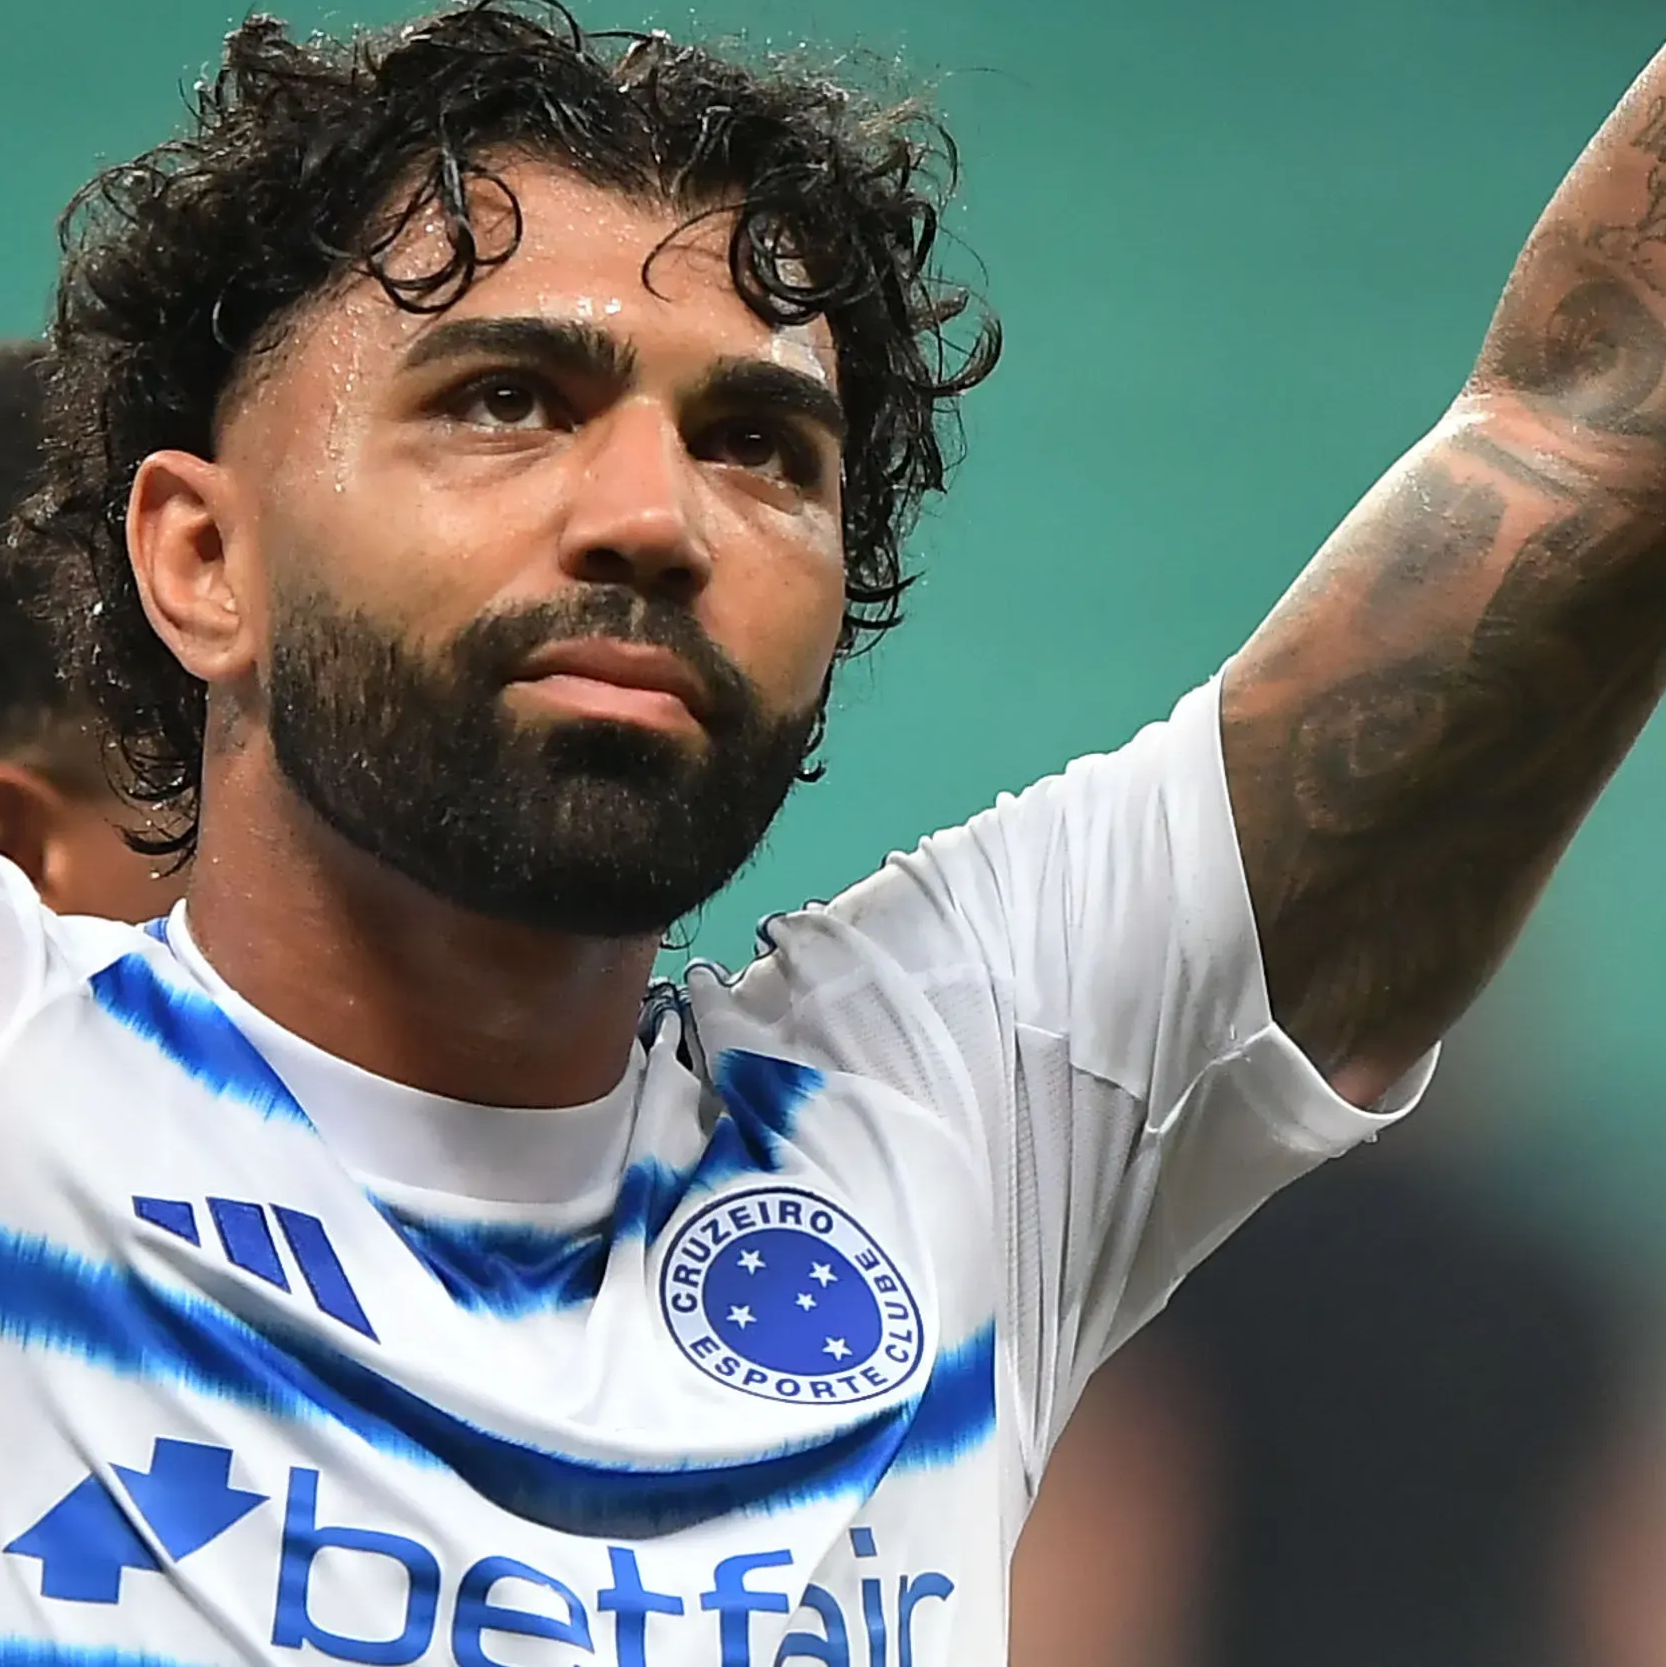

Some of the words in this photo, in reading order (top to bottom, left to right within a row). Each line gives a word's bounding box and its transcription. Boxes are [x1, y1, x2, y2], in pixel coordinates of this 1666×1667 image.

[671, 1200, 833, 1313] CRUZEIRO
[689, 1335, 888, 1398] ESPORTE
[854, 1247, 913, 1364] CLUBE
[271, 1467, 955, 1667] betfair
